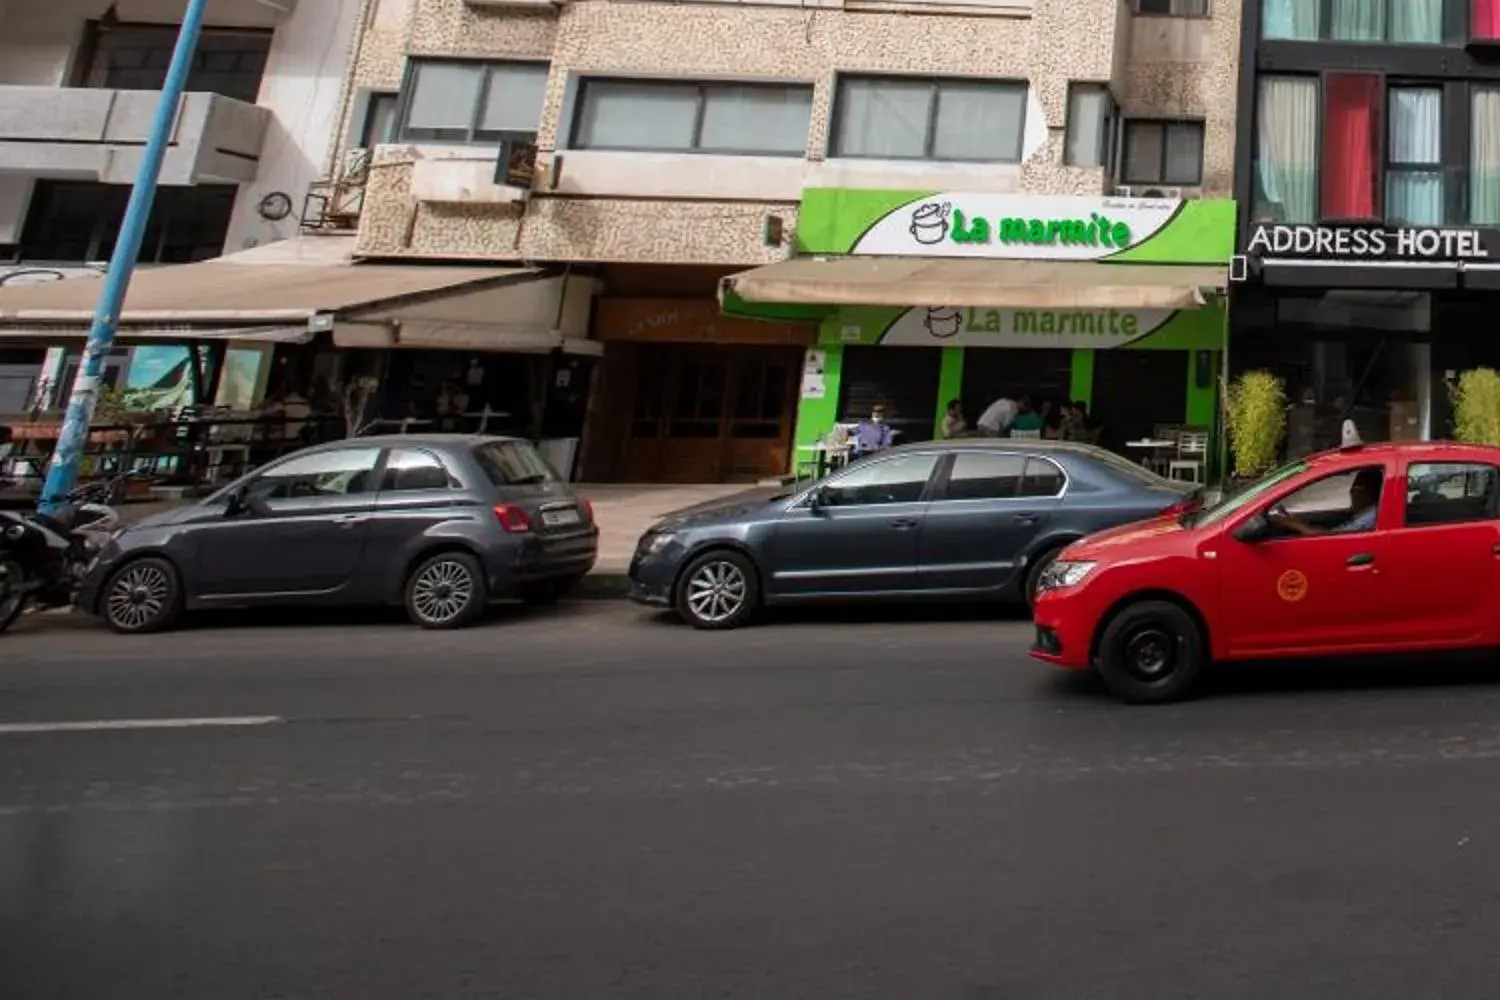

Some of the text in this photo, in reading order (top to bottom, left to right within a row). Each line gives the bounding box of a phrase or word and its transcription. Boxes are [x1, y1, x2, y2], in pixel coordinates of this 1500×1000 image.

[950, 209, 1134, 250] La marmite
[1247, 226, 1489, 257] ADDRESS HOTEL
[965, 307, 1139, 335] La marmite
